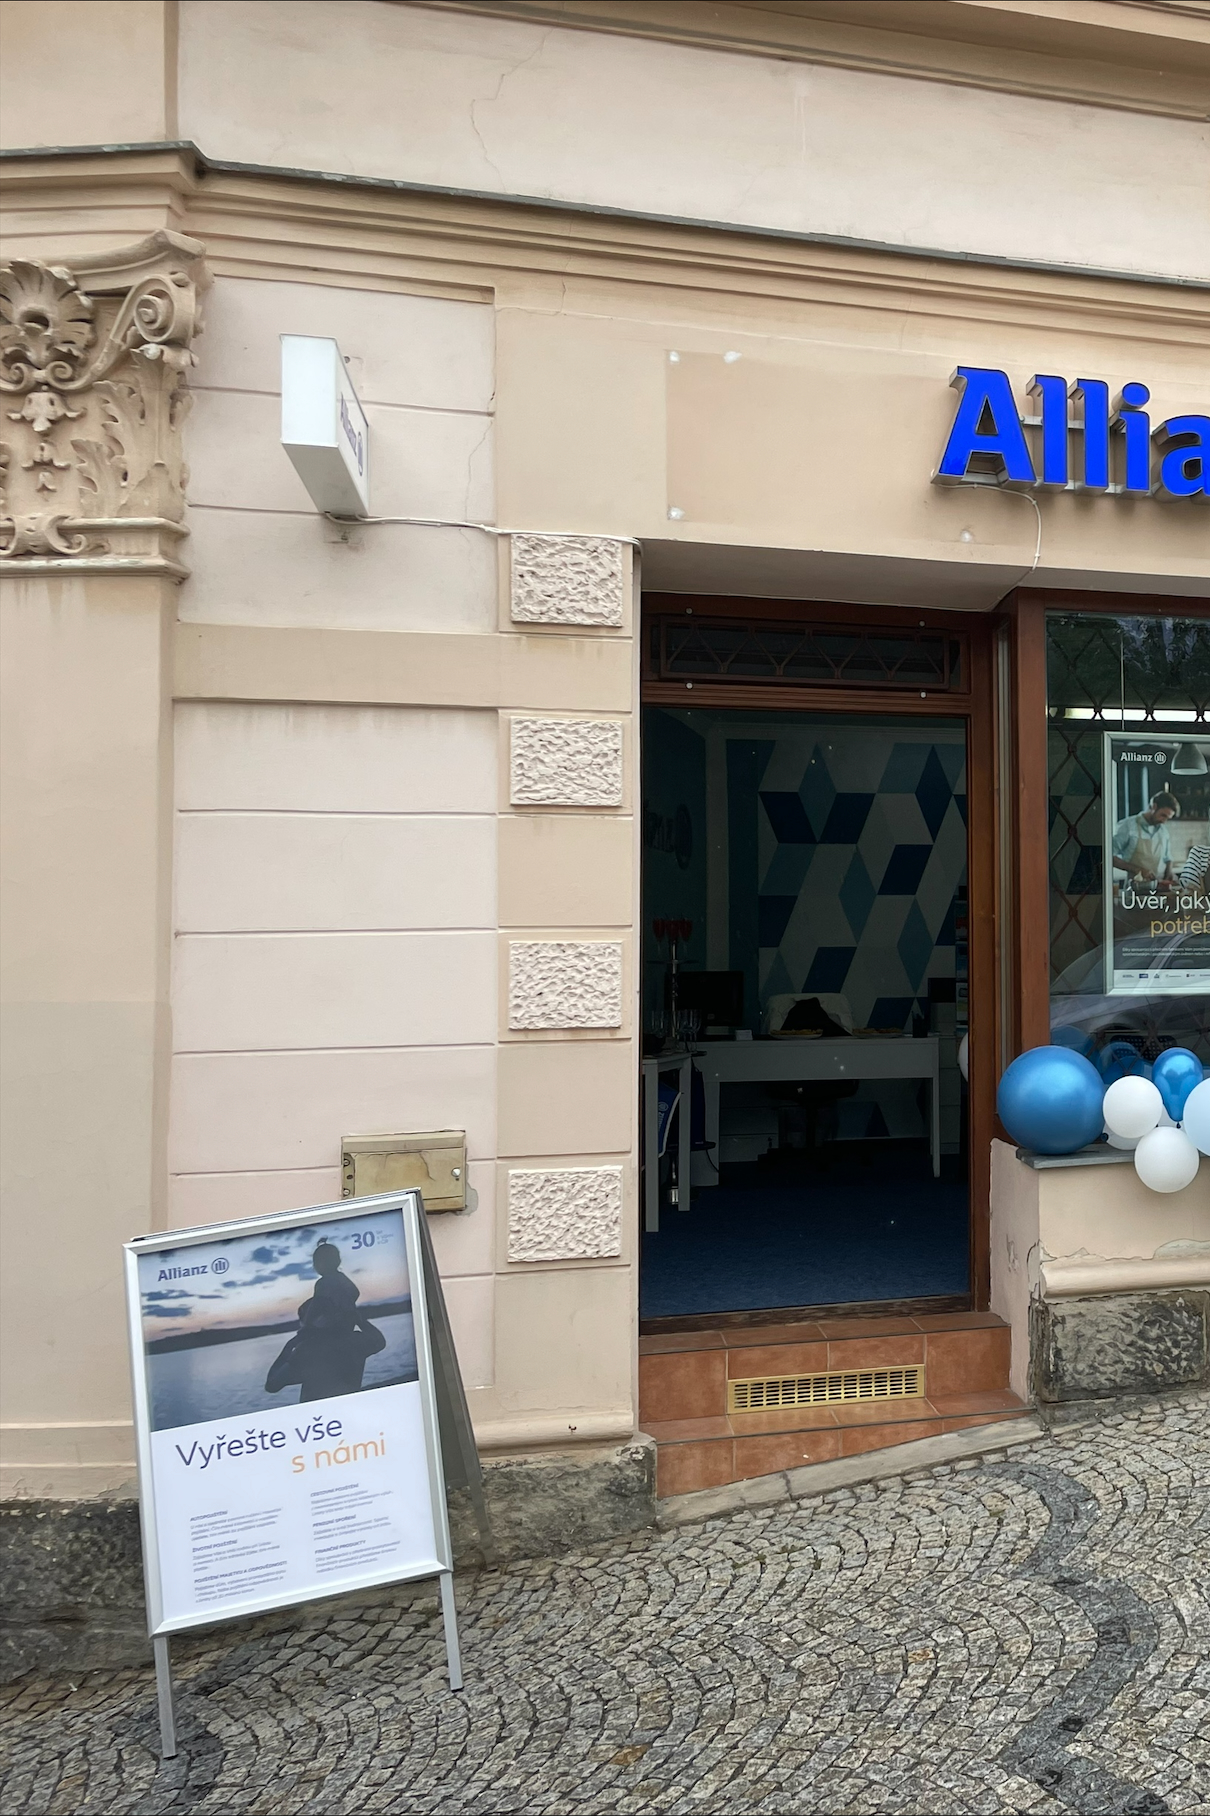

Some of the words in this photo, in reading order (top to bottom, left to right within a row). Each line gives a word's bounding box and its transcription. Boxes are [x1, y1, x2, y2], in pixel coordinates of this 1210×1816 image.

[1121, 752, 1153, 762] Allianz
[1121, 886, 1170, 912] Úvěr,
[351, 1230, 375, 1250] 30
[157, 1265, 209, 1282] Allianz
[175, 1429, 286, 1469] Vyřešte
[295, 1416, 343, 1443] vše
[292, 1454, 306, 1473] s
[314, 1432, 386, 1468] námi
